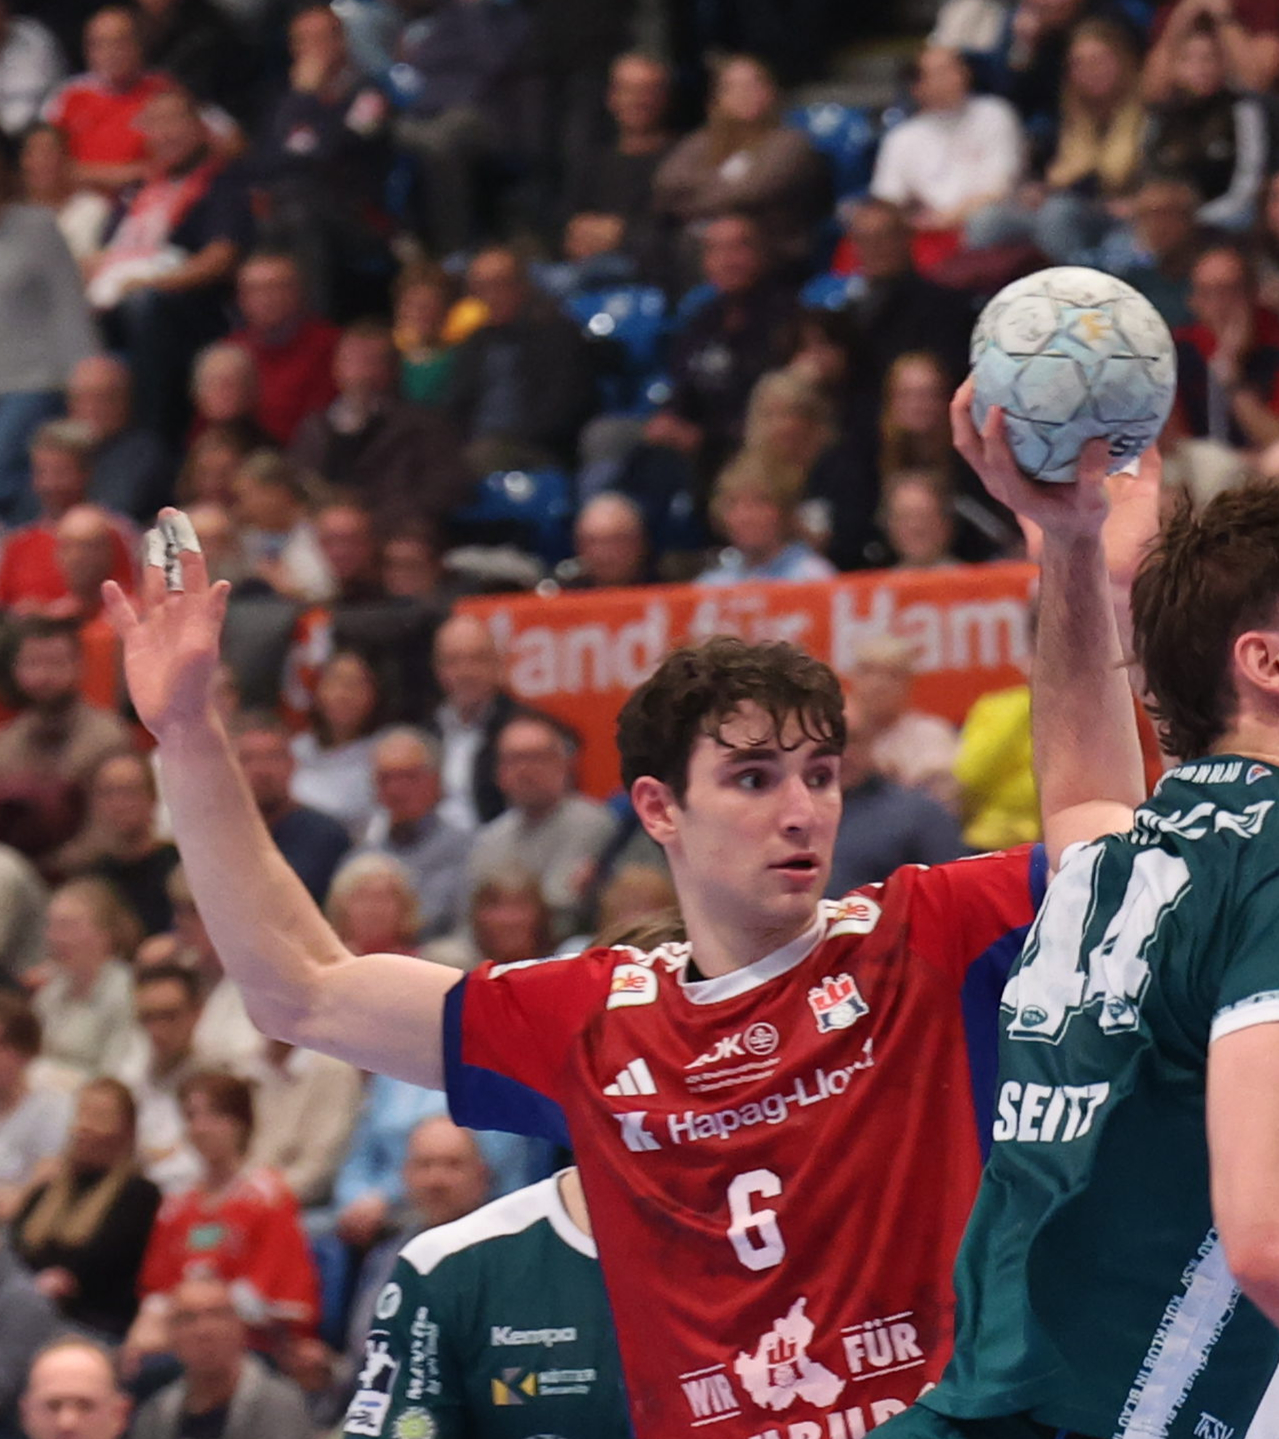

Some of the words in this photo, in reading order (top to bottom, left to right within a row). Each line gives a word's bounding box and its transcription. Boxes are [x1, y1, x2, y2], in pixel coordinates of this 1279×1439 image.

[486, 608, 669, 698] and
[726, 1167, 787, 1272] 6
[842, 1317, 924, 1375] FÜR
